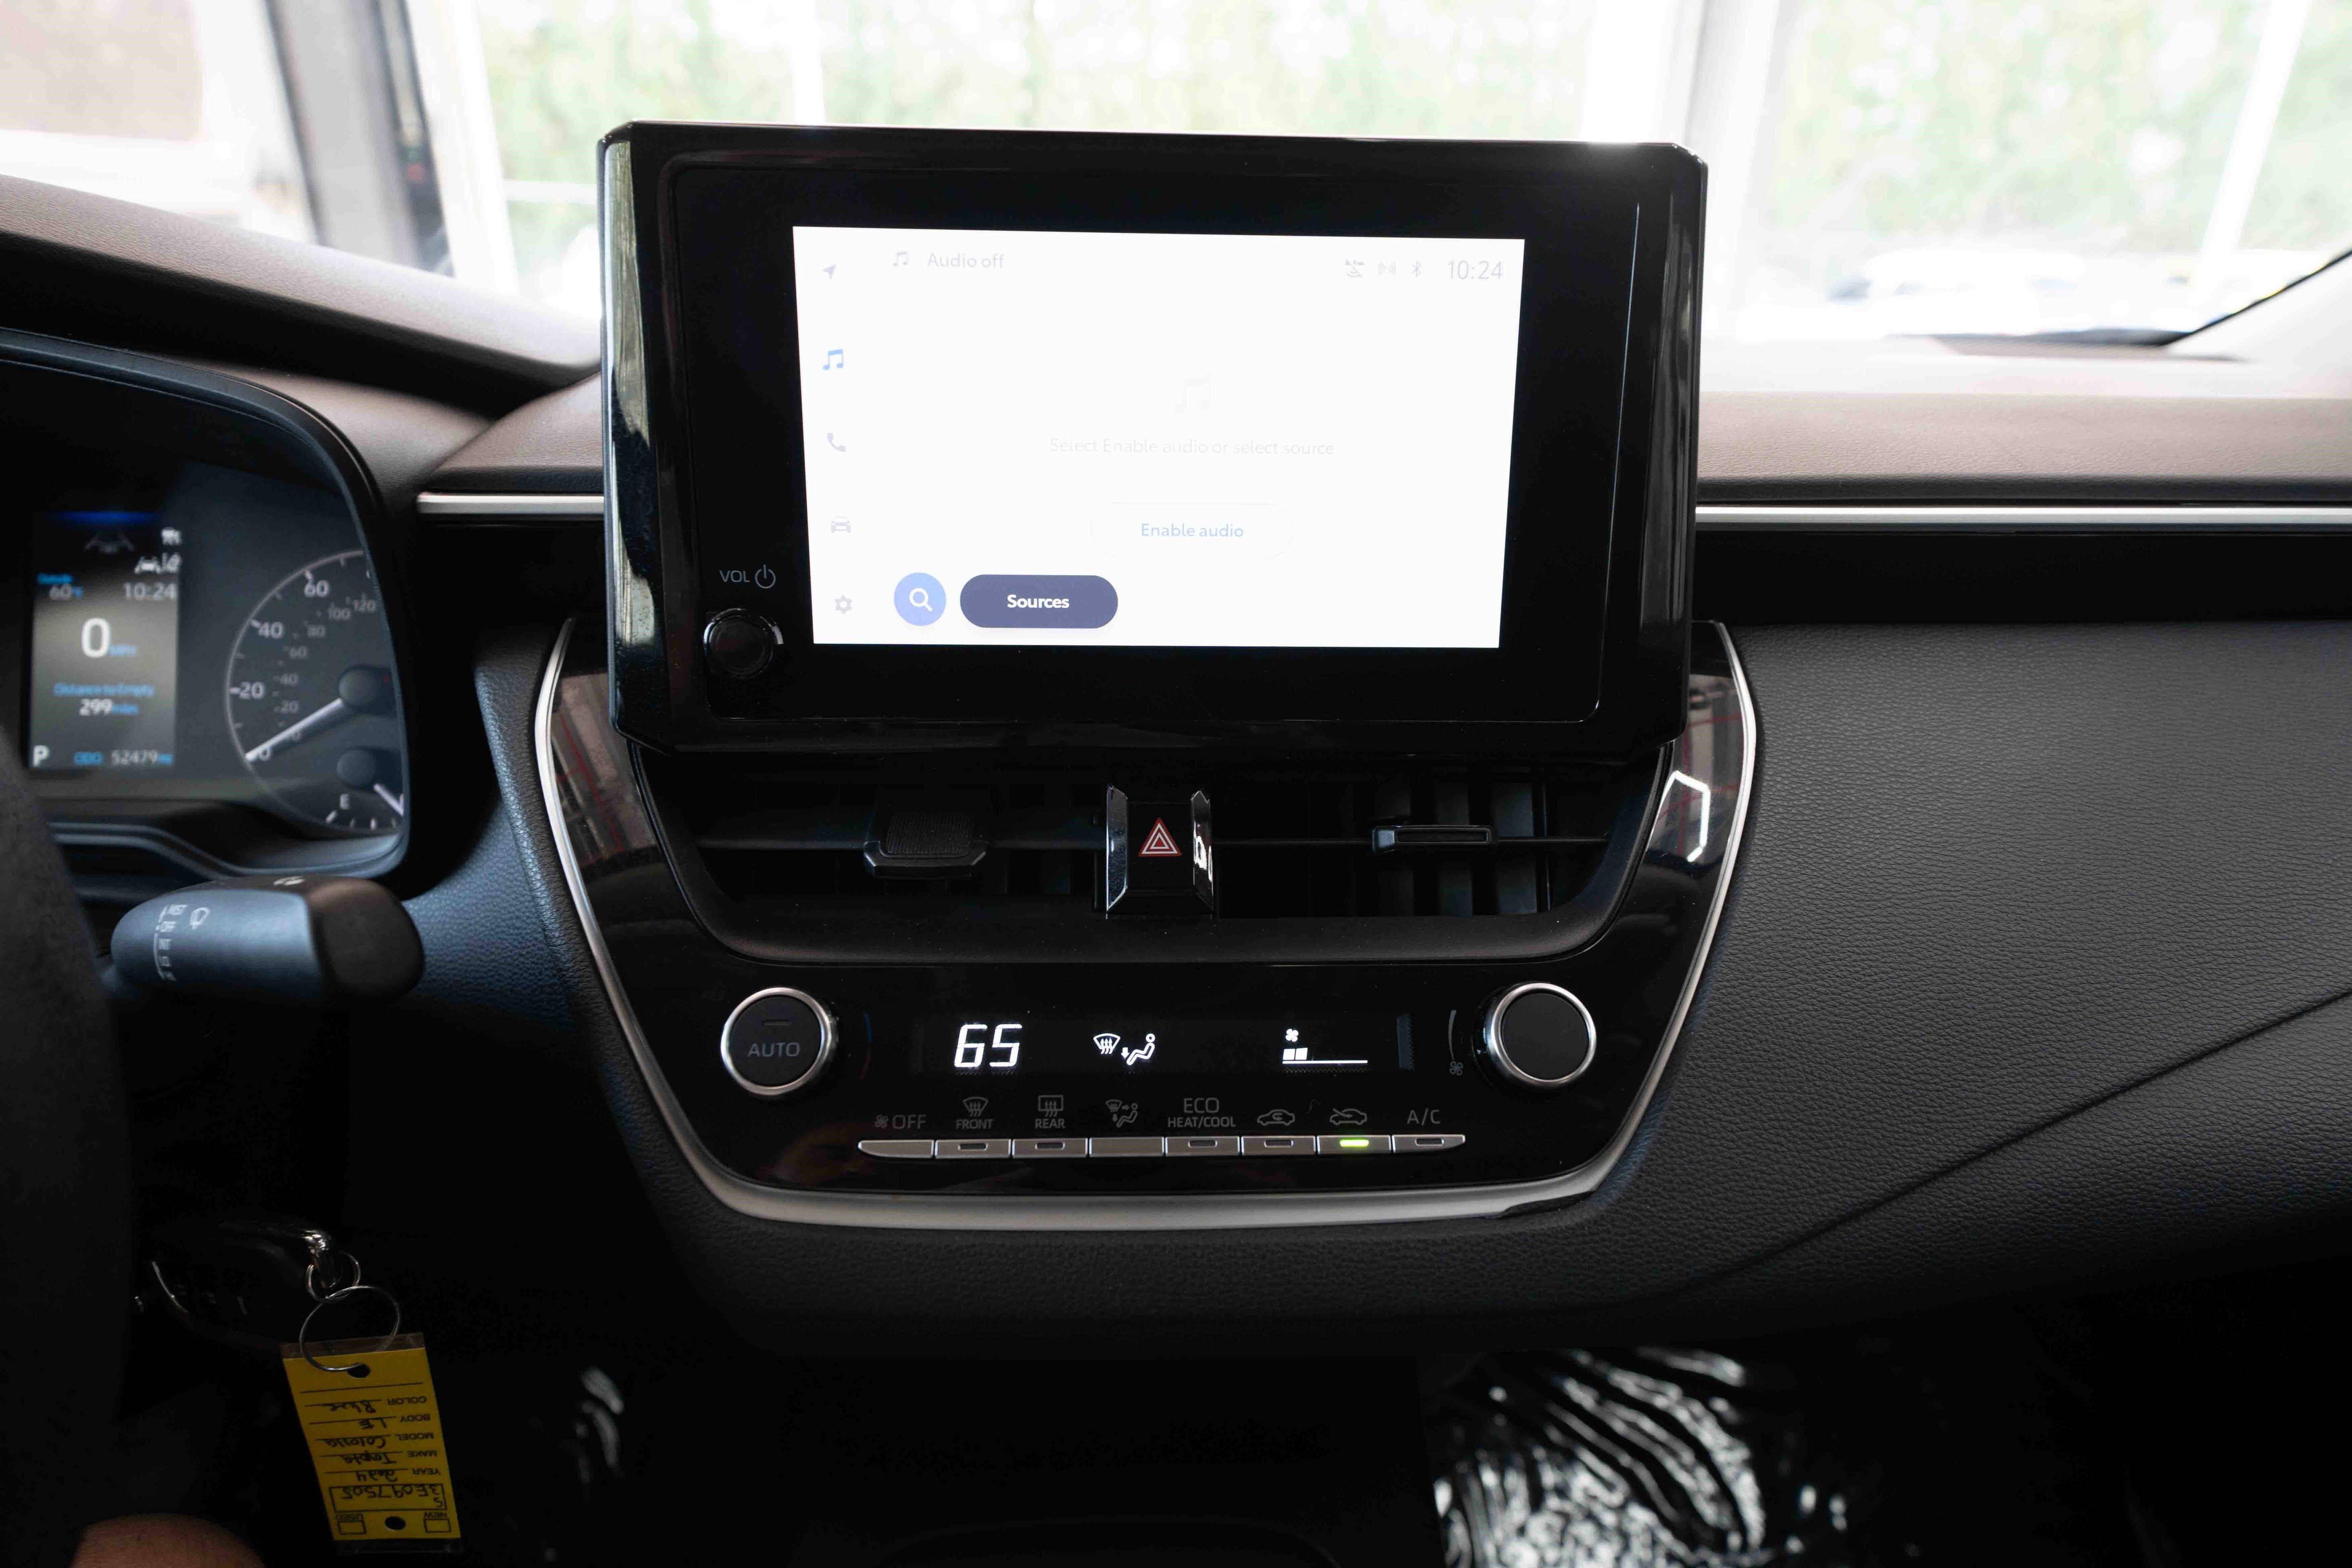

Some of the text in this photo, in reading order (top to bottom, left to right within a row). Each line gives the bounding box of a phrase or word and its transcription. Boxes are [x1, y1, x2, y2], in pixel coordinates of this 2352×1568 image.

[927, 252, 1005, 269] Audio off
[1447, 260, 1504, 280] 10:24
[1050, 438, 1335, 455] Select Enable audio or select source
[1140, 523, 1245, 538] Enable audio
[719, 570, 750, 583] VOL
[124, 582, 178, 601] 10:24
[304, 580, 330, 597] 60
[1007, 595, 1070, 609] Sources
[328, 608, 351, 620] 100
[258, 621, 284, 639] 40
[82, 618, 110, 658] 0
[280, 673, 299, 686] 40
[240, 682, 265, 699] 20
[79, 698, 113, 716] 299
[281, 700, 299, 713] 20
[33, 745, 50, 766] P
[340, 793, 350, 810] E
[748, 1042, 800, 1057] AUTO
[954, 1024, 1022, 1068] 65
[1184, 1098, 1220, 1114] ECO
[893, 1115, 926, 1129] OFF
[956, 1118, 993, 1129] FRONT
[1035, 1118, 1066, 1129] REAR
[1167, 1117, 1236, 1128] HEAT/COOL
[1407, 1108, 1441, 1125] A/C
[387, 1396, 427, 1405] COLOR
[400, 1414, 430, 1423] BODY
[395, 1433, 434, 1441] MODEL
